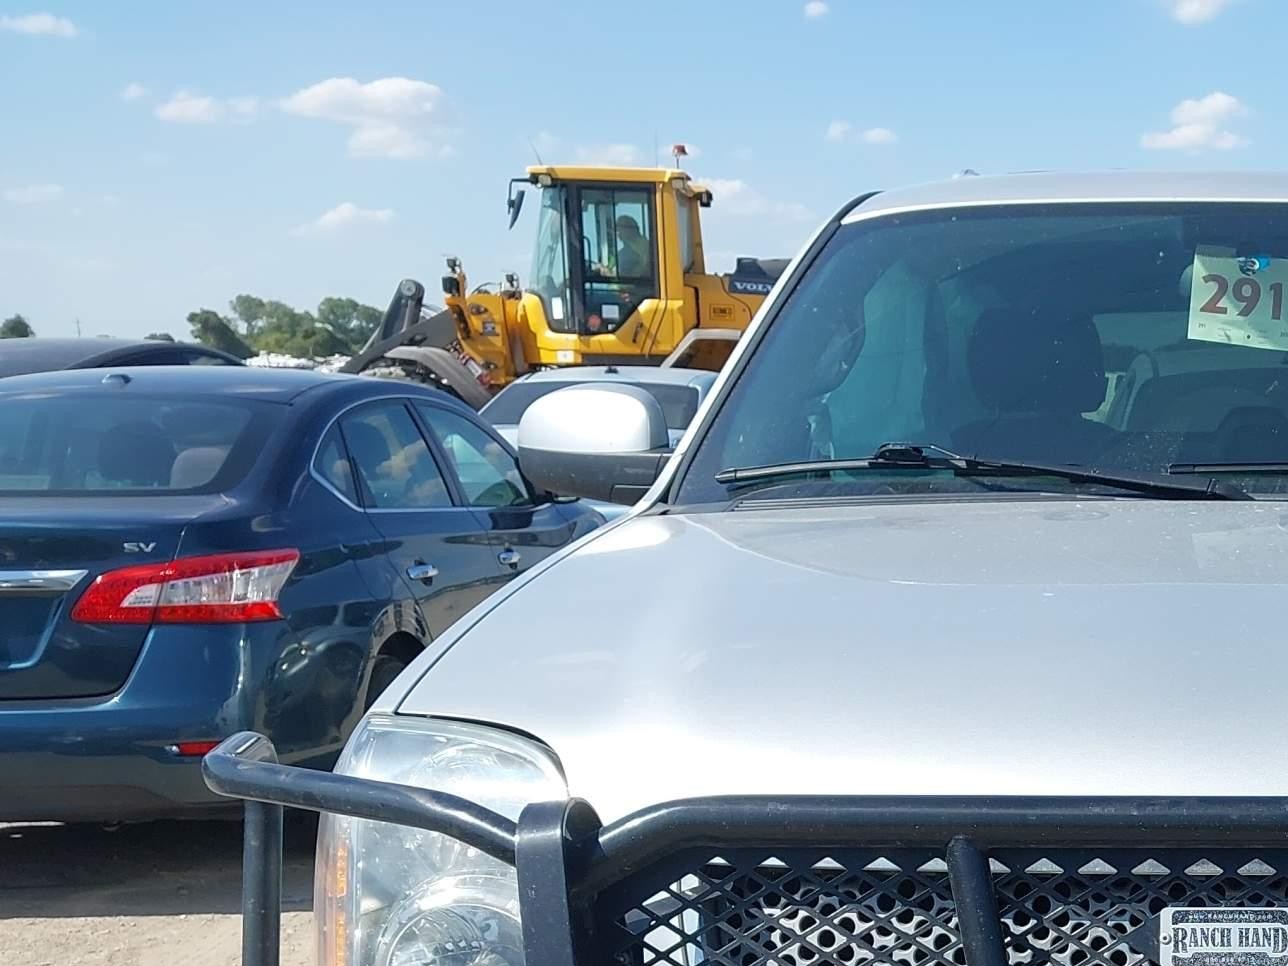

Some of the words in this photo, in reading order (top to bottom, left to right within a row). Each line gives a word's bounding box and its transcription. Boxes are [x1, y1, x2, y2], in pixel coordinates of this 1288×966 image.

[733, 281, 772, 292] VOLV
[1199, 273, 1283, 321] 291
[123, 542, 157, 553] SV
[1172, 926, 1233, 953] RANCH
[1238, 926, 1288, 953] HAND
